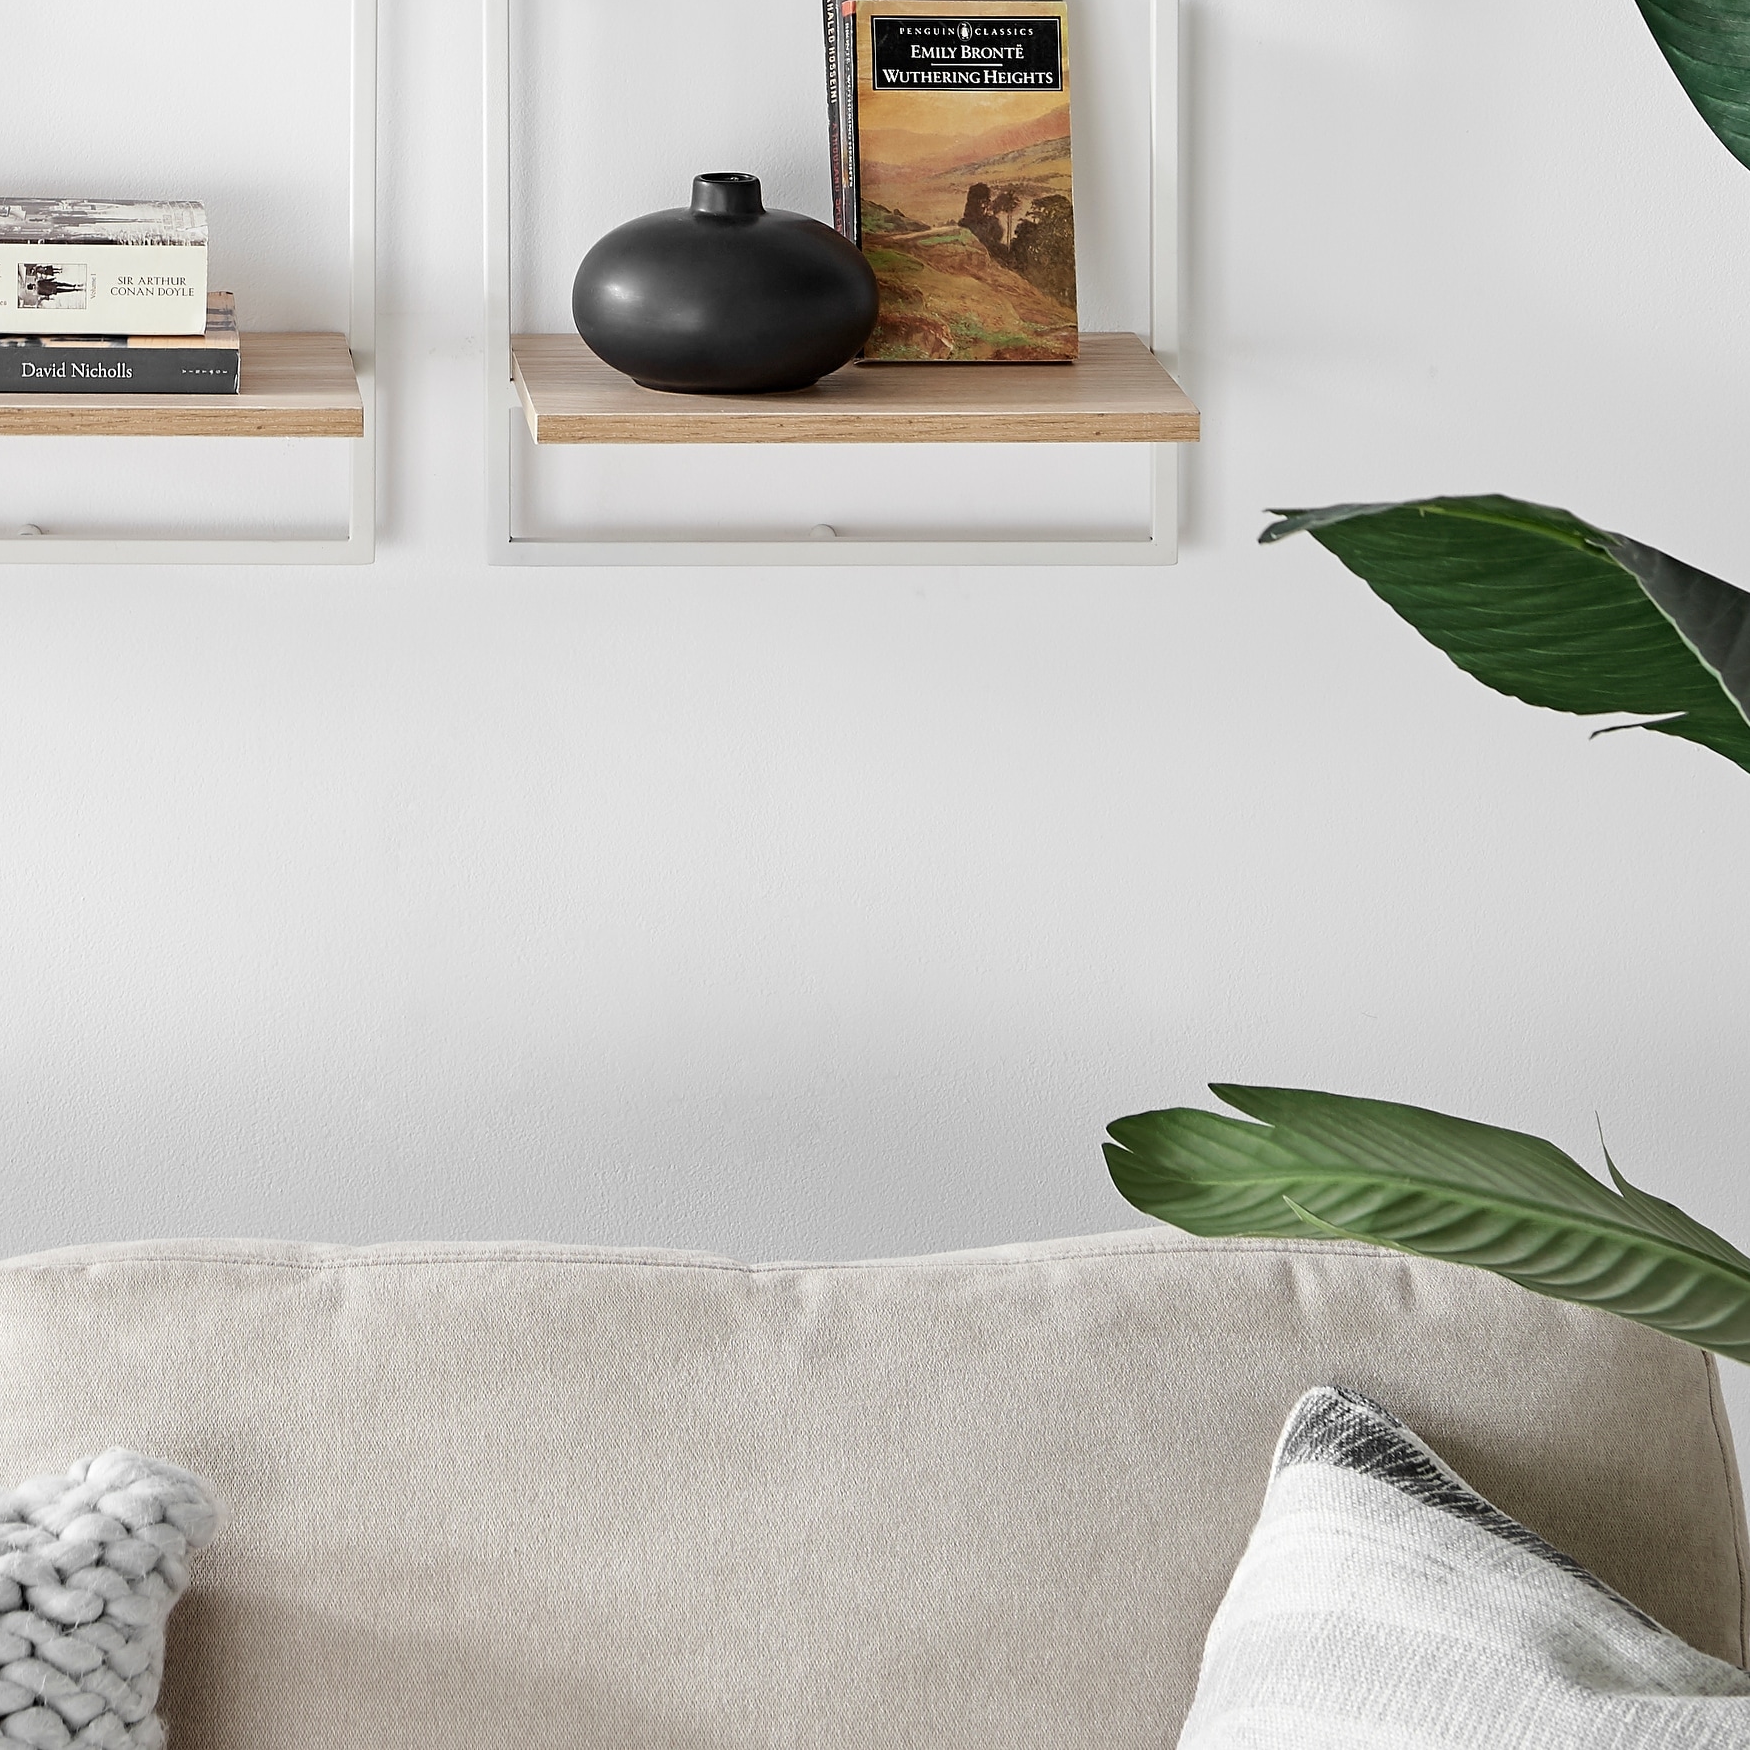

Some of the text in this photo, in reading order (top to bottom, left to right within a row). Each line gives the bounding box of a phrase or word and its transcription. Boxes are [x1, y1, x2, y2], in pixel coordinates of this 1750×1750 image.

[899, 27, 1034, 36] PENGUIN CLASSICS
[910, 44, 1025, 59] EMILY BRONTË
[828, 47, 837, 104] HOSSEINI
[882, 69, 1054, 84] WUTHERING HEIGHTS
[117, 276, 187, 286] SIR ARTHUR
[110, 286, 195, 297] CONAN DOYLE
[21, 362, 133, 378] David Nicholls
